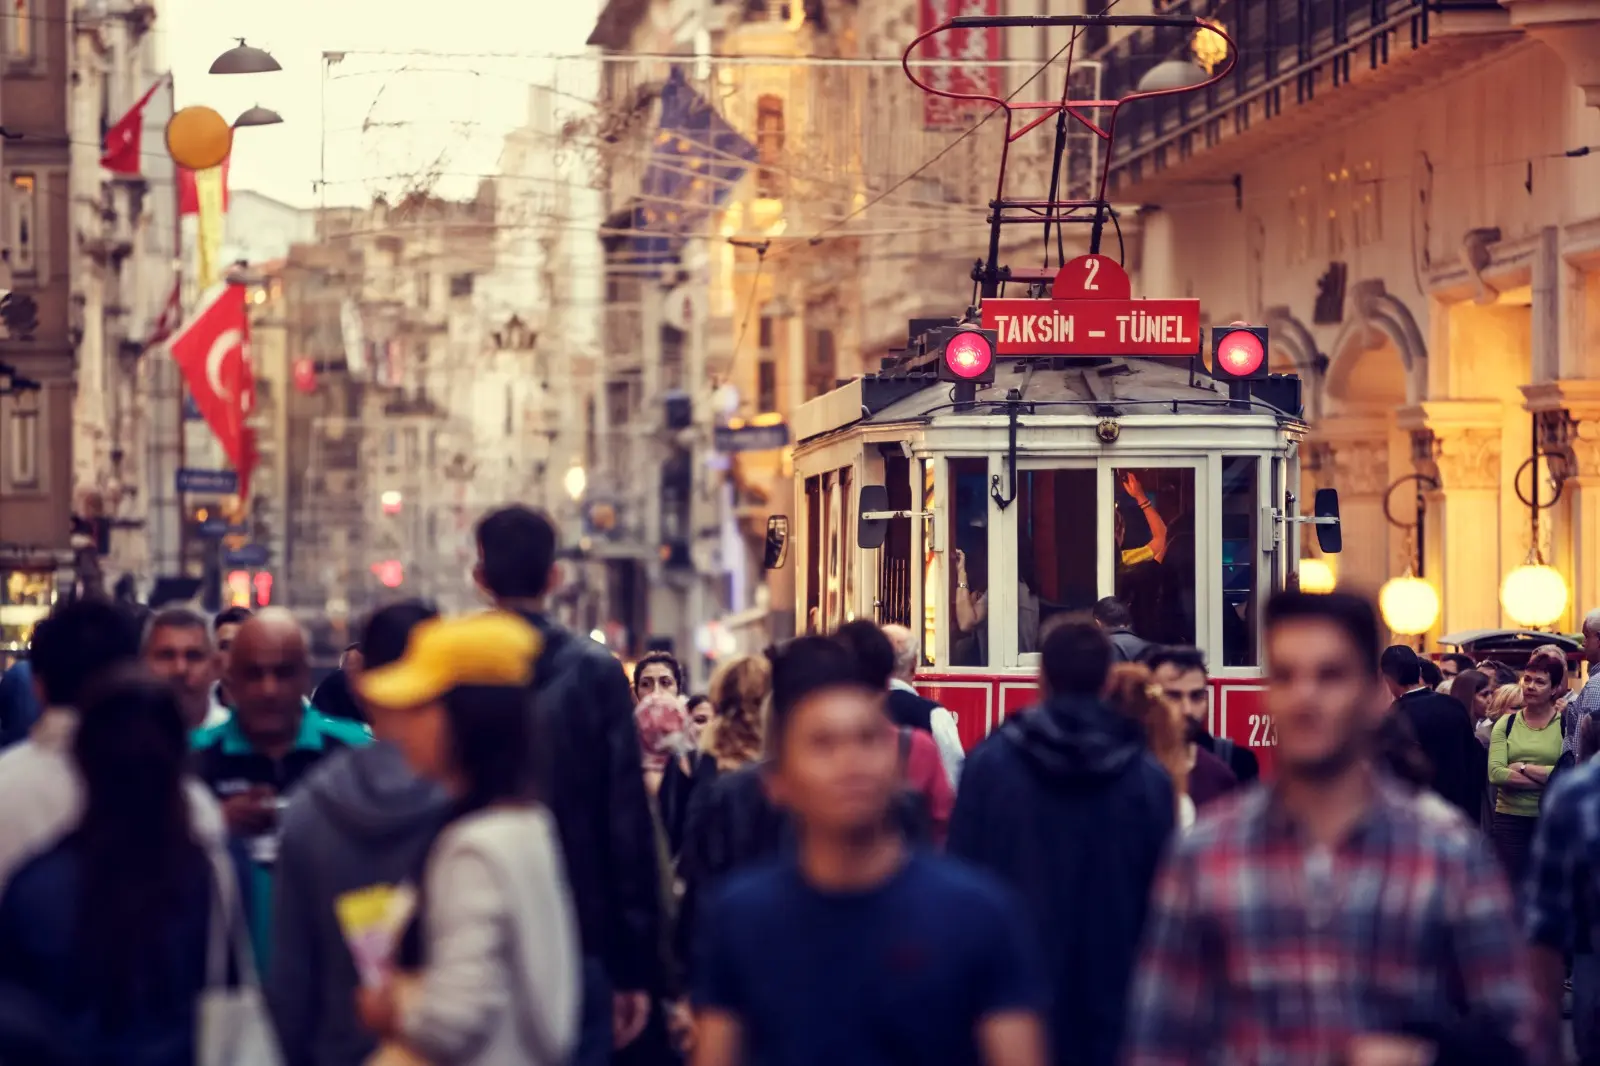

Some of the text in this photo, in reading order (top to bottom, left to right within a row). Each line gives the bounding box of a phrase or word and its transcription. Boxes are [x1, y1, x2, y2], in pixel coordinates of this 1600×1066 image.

[1084, 258, 1100, 290] 2
[995, 310, 1075, 343] TAKSİM
[1116, 310, 1191, 343] TÜNEL
